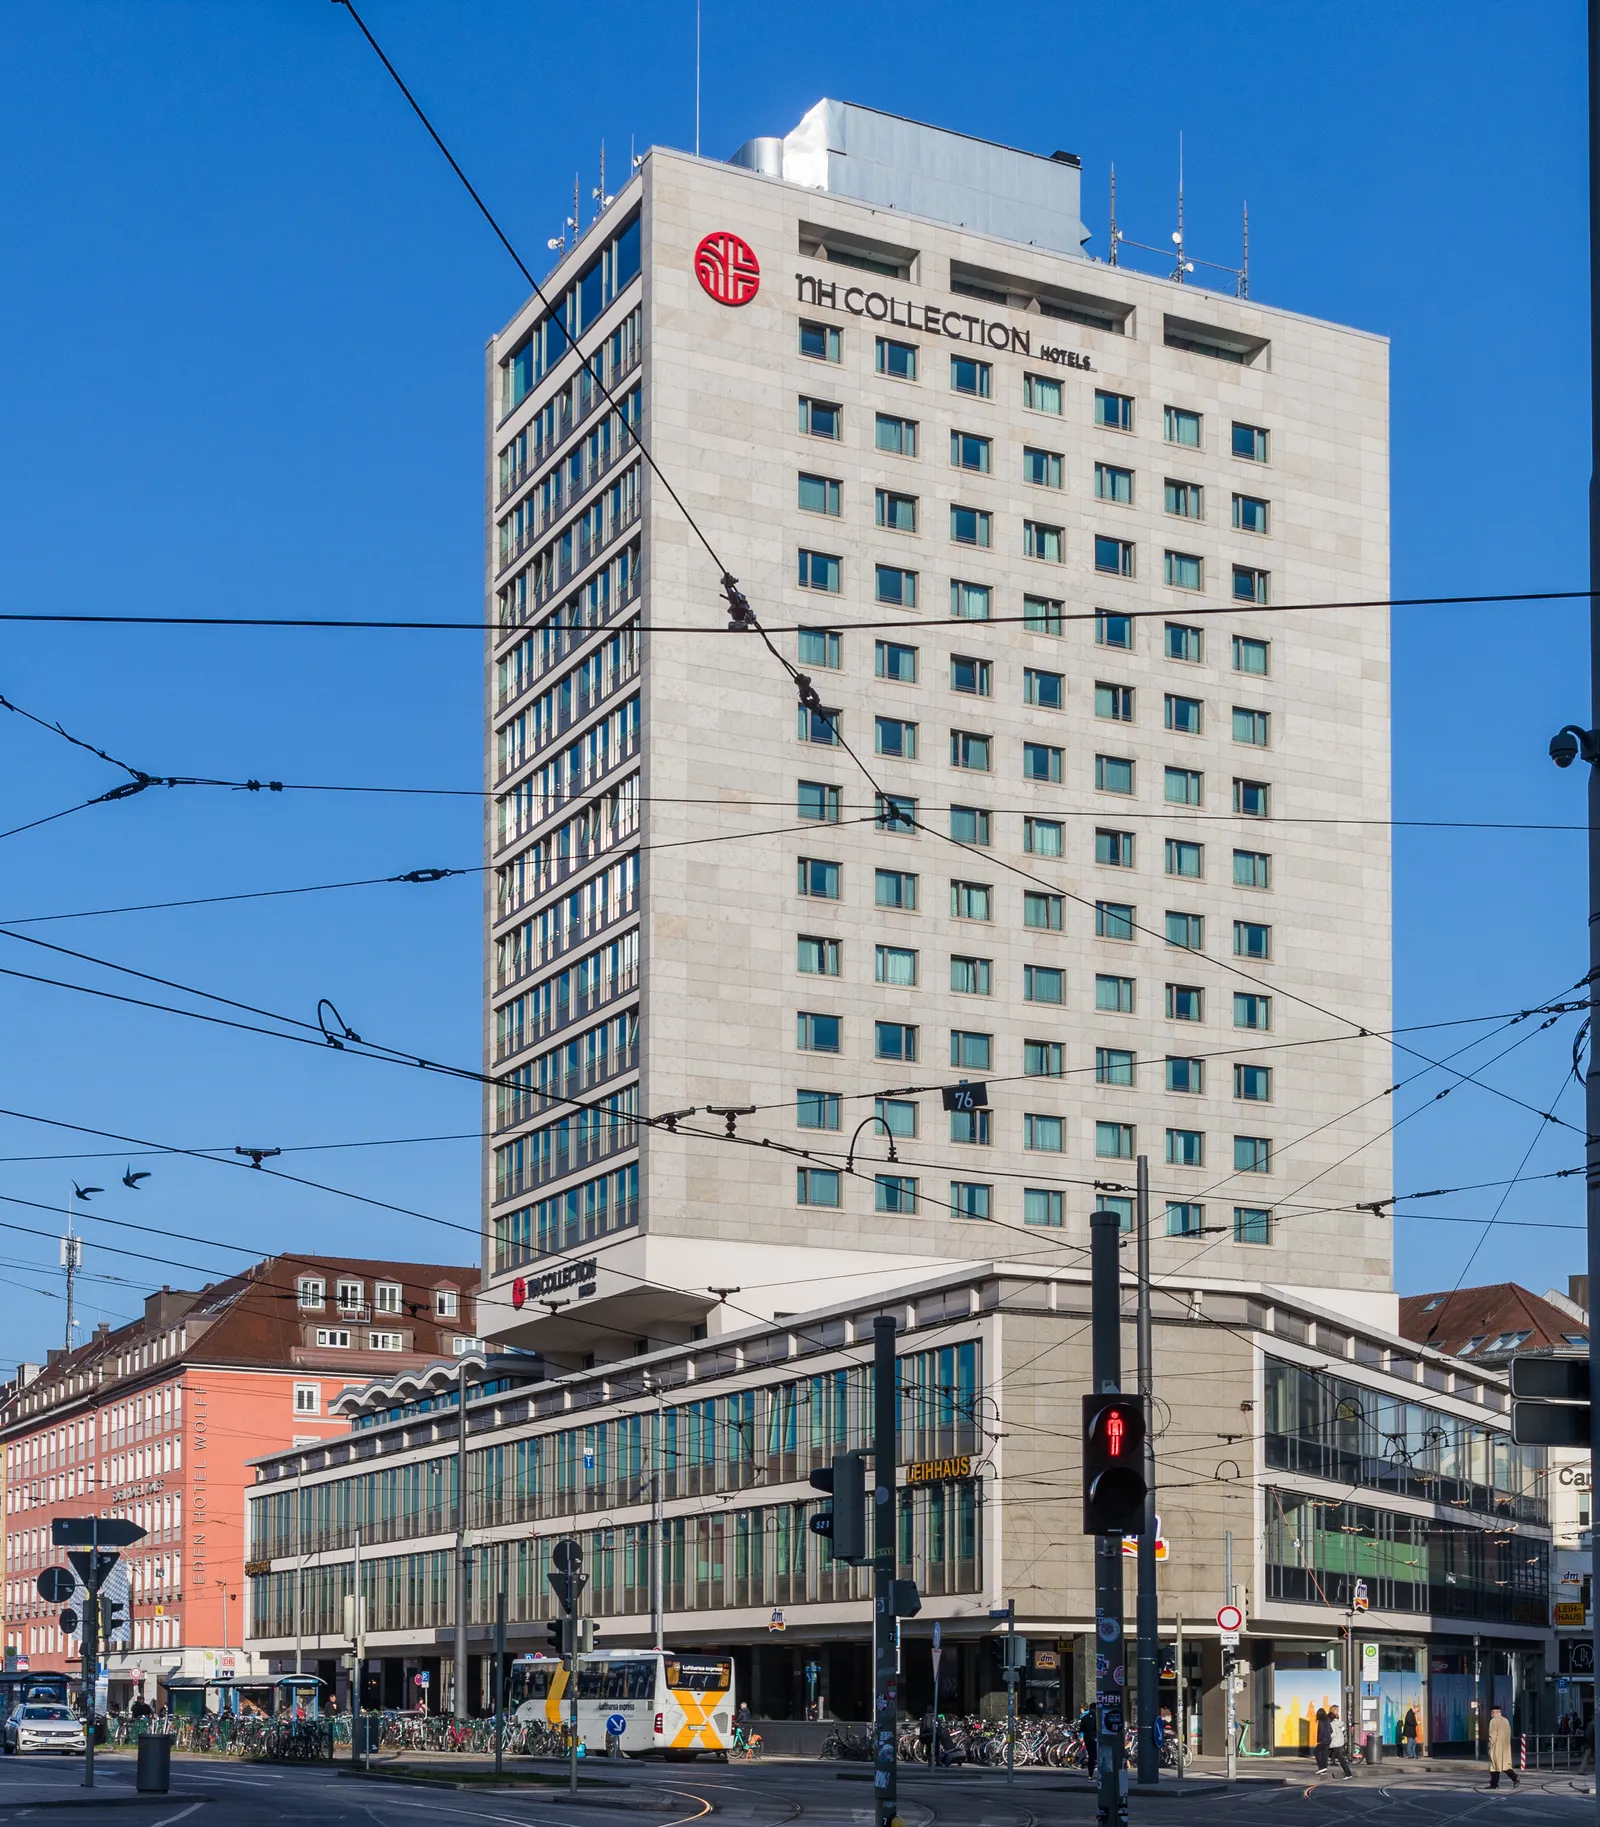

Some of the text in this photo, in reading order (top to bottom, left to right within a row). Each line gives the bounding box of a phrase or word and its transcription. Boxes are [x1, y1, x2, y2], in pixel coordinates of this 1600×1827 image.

[844, 286, 1031, 356] COLLECTION
[1040, 344, 1091, 371] HOTELS
[954, 1091, 974, 1110] 76
[906, 1456, 971, 1483] LEIHHAUS
[192, 1384, 208, 1585] EDEN HOTEL WOLFF
[1563, 1571, 1579, 1580] dm
[771, 1607, 783, 1622] dm
[1557, 1605, 1583, 1613] LEIH-
[1557, 1613, 1583, 1621] HAUS
[223, 1657, 234, 1666] DB
[1040, 1653, 1054, 1662] dm
